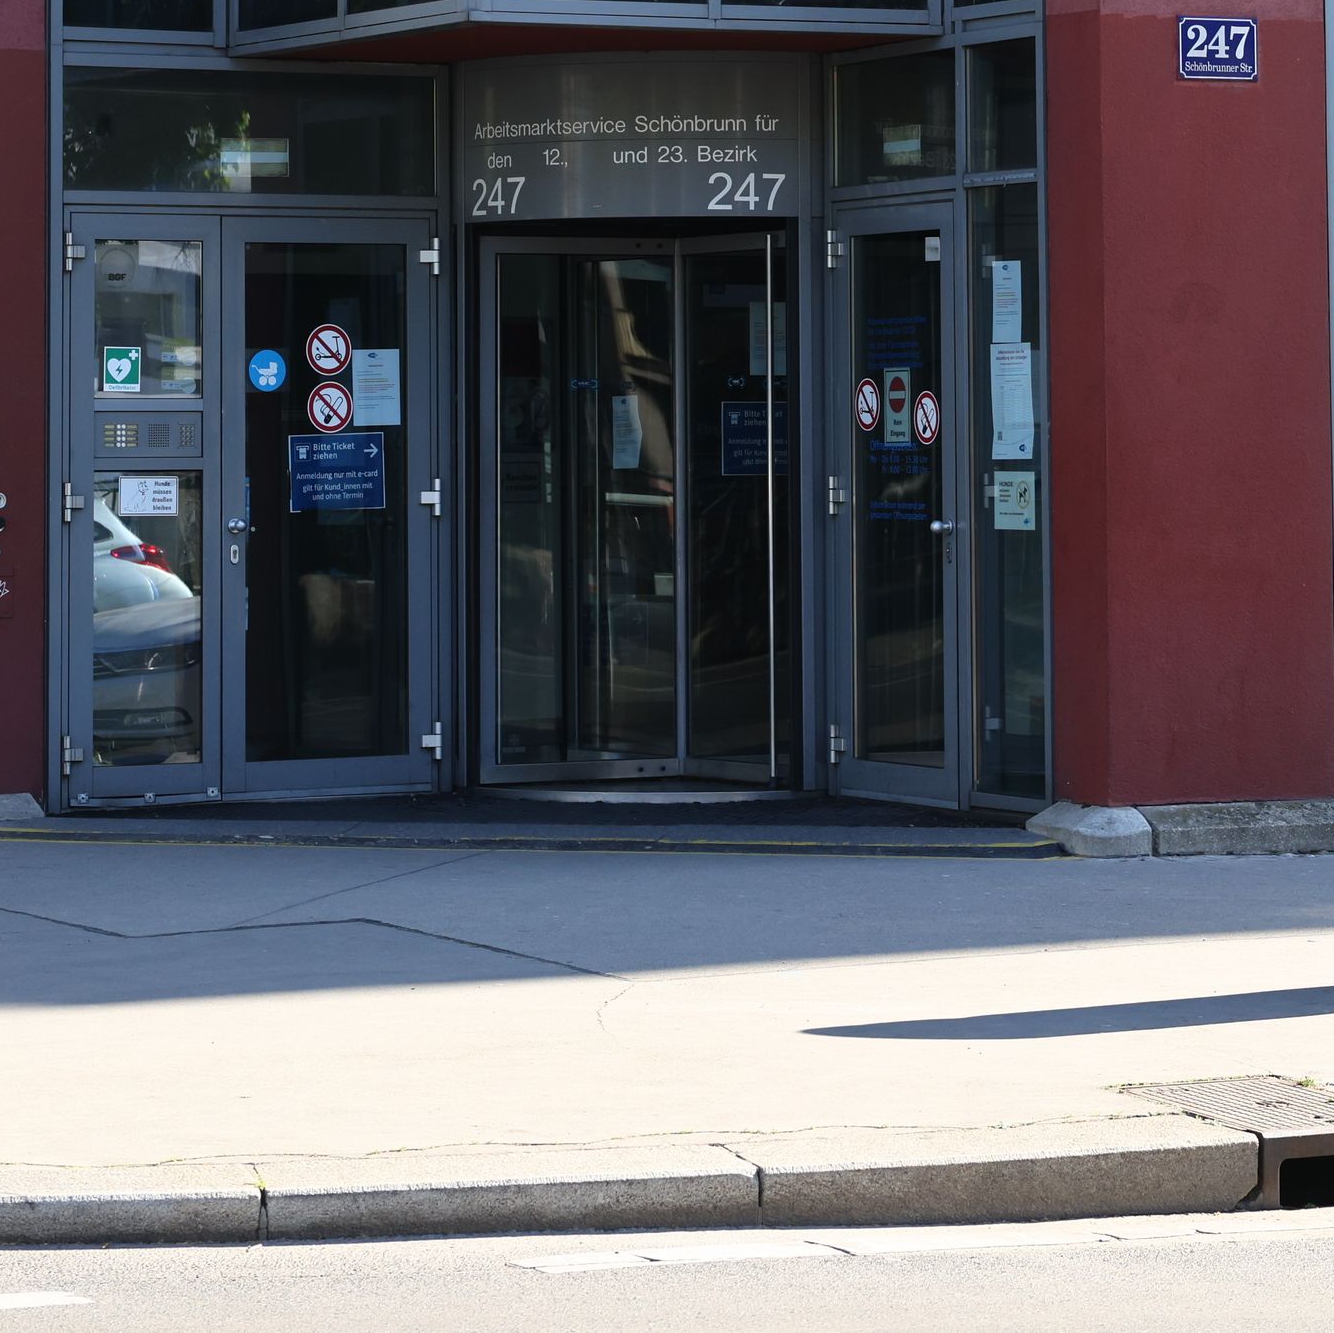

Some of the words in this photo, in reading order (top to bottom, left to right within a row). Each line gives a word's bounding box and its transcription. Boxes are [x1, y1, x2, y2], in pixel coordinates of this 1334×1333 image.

[1186, 24, 1250, 60] 247
[1185, 61, 1239, 73] Schönbrunner
[1239, 62, 1253, 73] Str.
[474, 117, 626, 140] Arbeitsmarktservice
[635, 114, 746, 134] Schönbrunn
[755, 114, 779, 133] für
[487, 152, 512, 170] den
[542, 148, 568, 168] 12.,
[613, 146, 648, 164] und
[658, 146, 688, 163] 23.
[697, 145, 758, 163] Bezirk
[472, 176, 525, 217] 247
[707, 172, 786, 211] 247
[332, 442, 355, 450] Ticket
[313, 452, 338, 460] ziehen
[296, 472, 333, 481] Anmeldung
[357, 469, 378, 478] e-card
[302, 484, 313, 493] gilt
[314, 483, 323, 491] für
[342, 491, 364, 499] Termin
